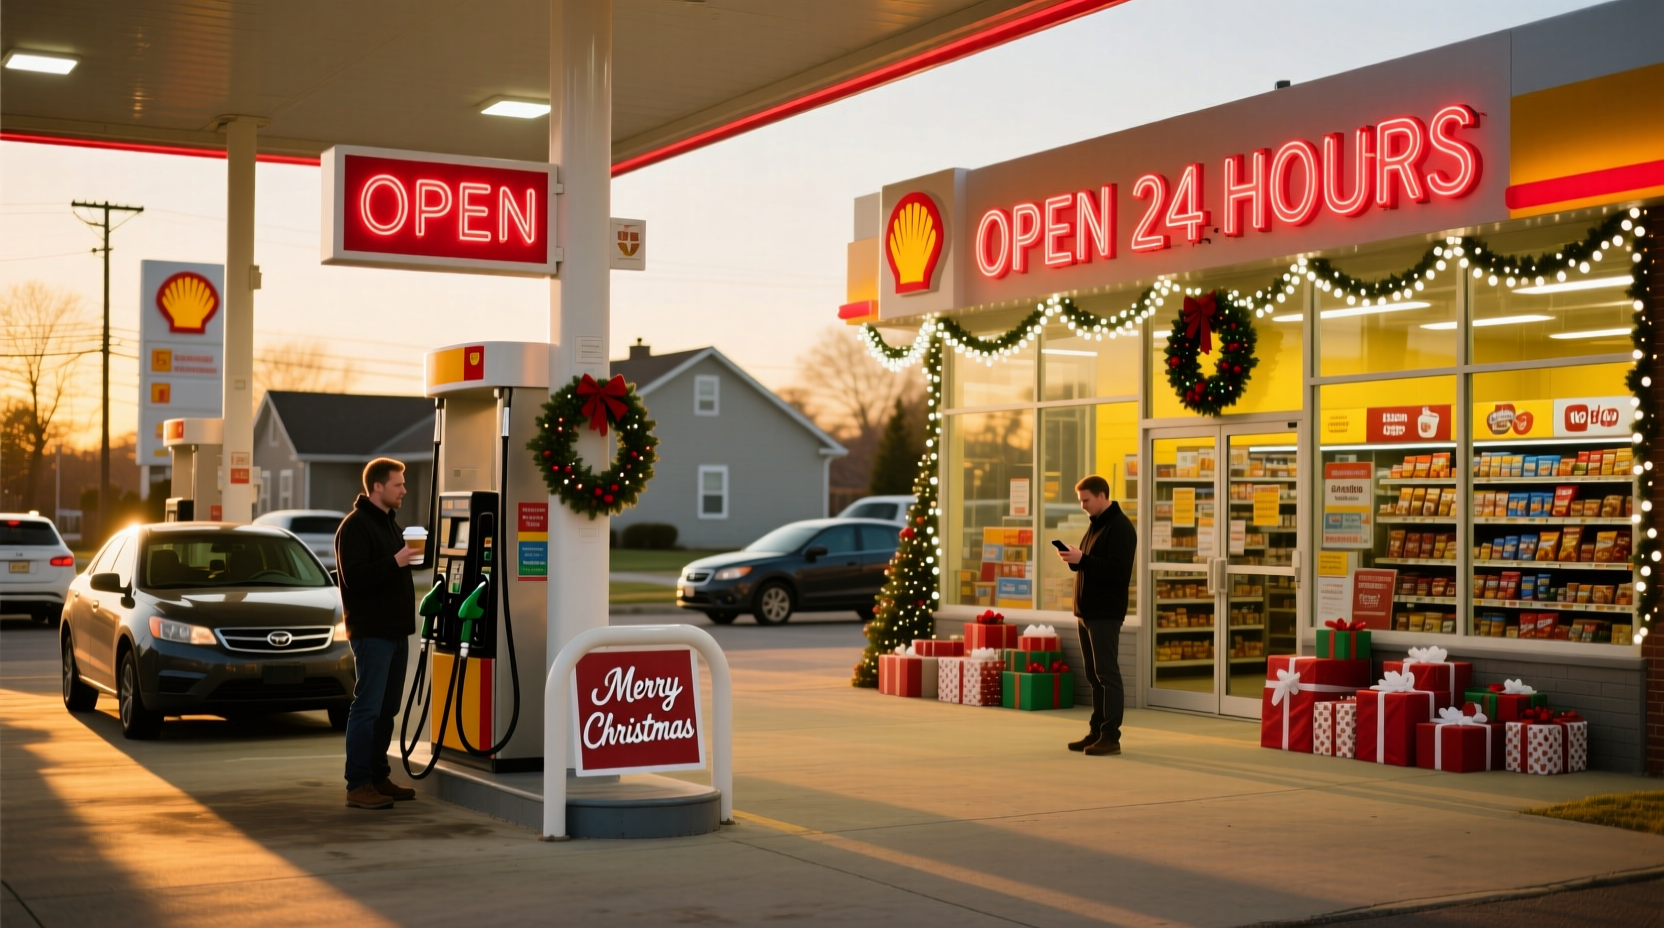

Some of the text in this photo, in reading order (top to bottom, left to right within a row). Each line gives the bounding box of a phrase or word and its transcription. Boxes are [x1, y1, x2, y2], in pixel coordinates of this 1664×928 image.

[360, 174, 536, 244] OPEN
[975, 104, 1484, 279] OPEN 24 HOURS
[591, 665, 683, 711] Merry
[583, 711, 695, 750] Christmas
